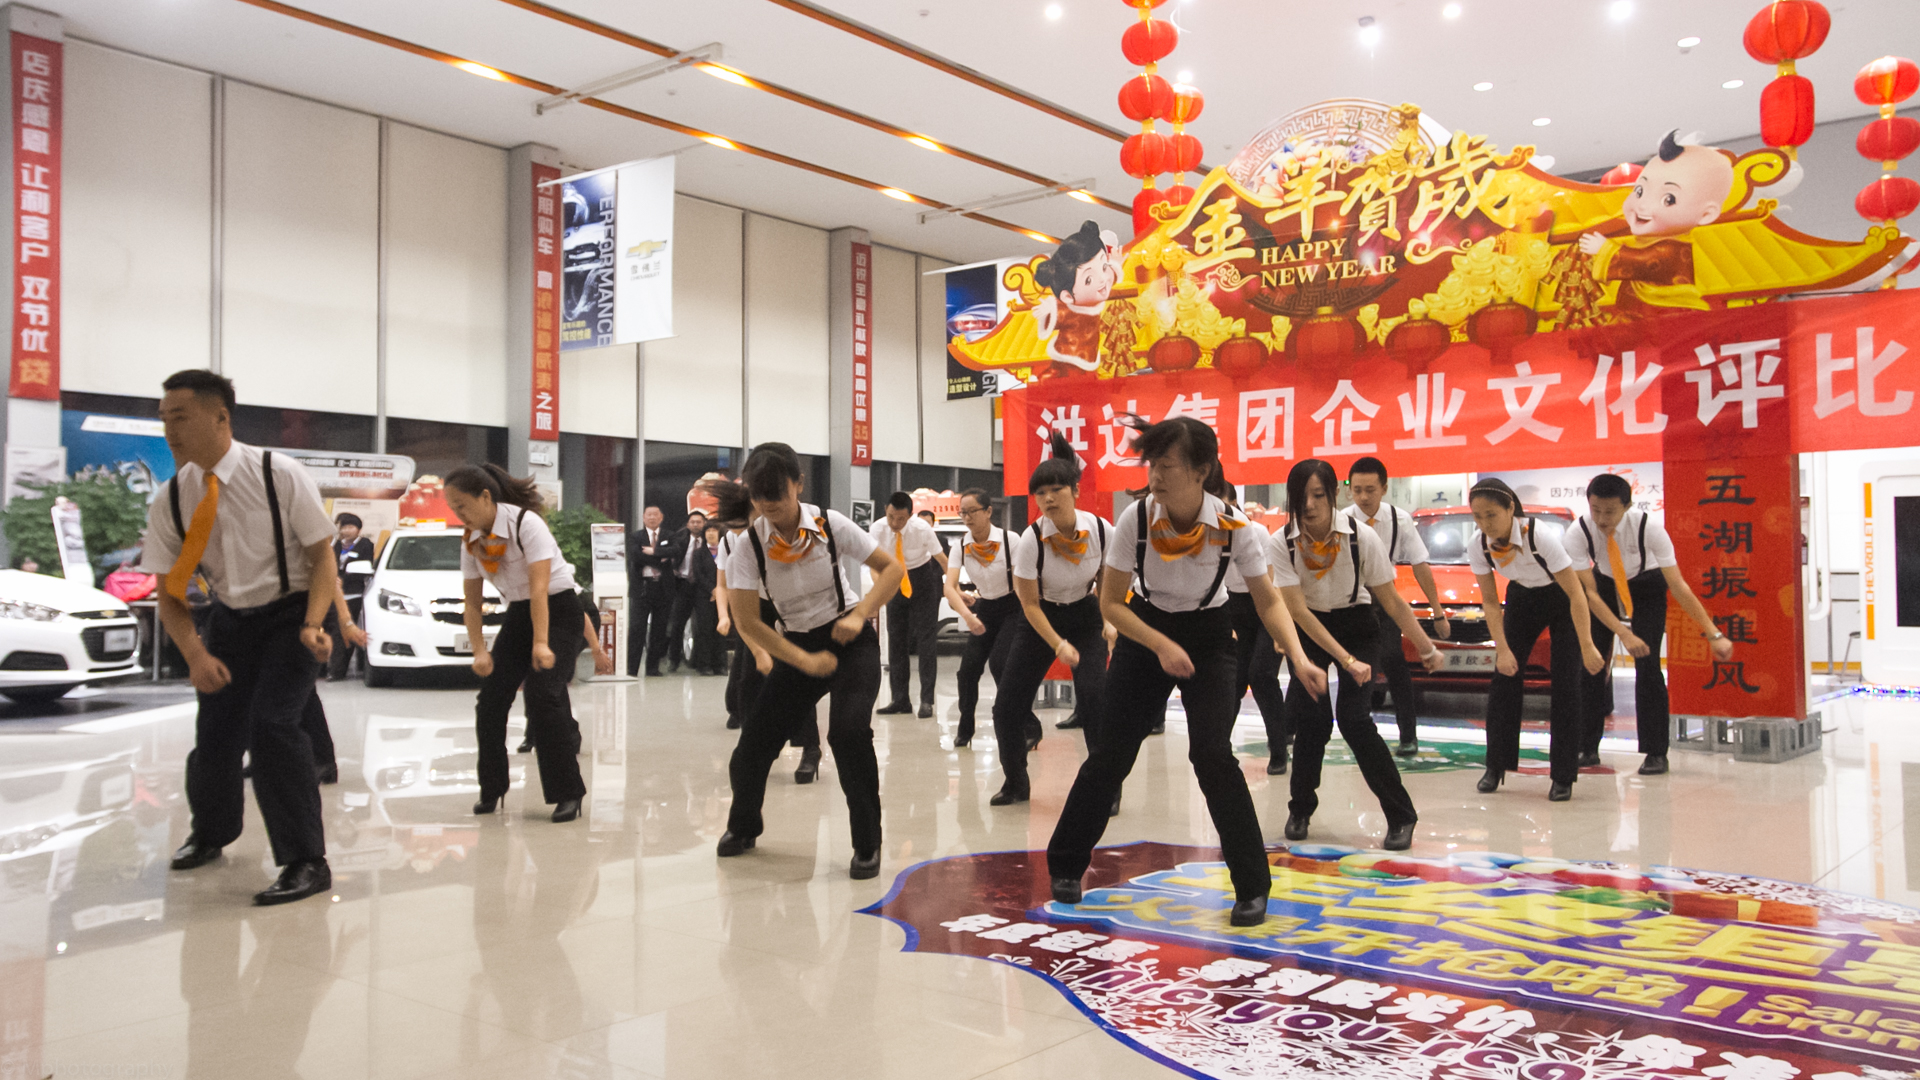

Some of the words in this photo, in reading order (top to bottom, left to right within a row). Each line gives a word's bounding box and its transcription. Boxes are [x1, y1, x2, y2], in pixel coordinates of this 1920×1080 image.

[20, 162, 50, 264] 让利客户
[1260, 238, 1347, 266] HAPPY
[1260, 264, 1320, 288] NEW
[1325, 255, 1397, 280] YEAR
[1864, 520, 1875, 603] CHEVROLET
[1757, 994, 1920, 1035] Sale
